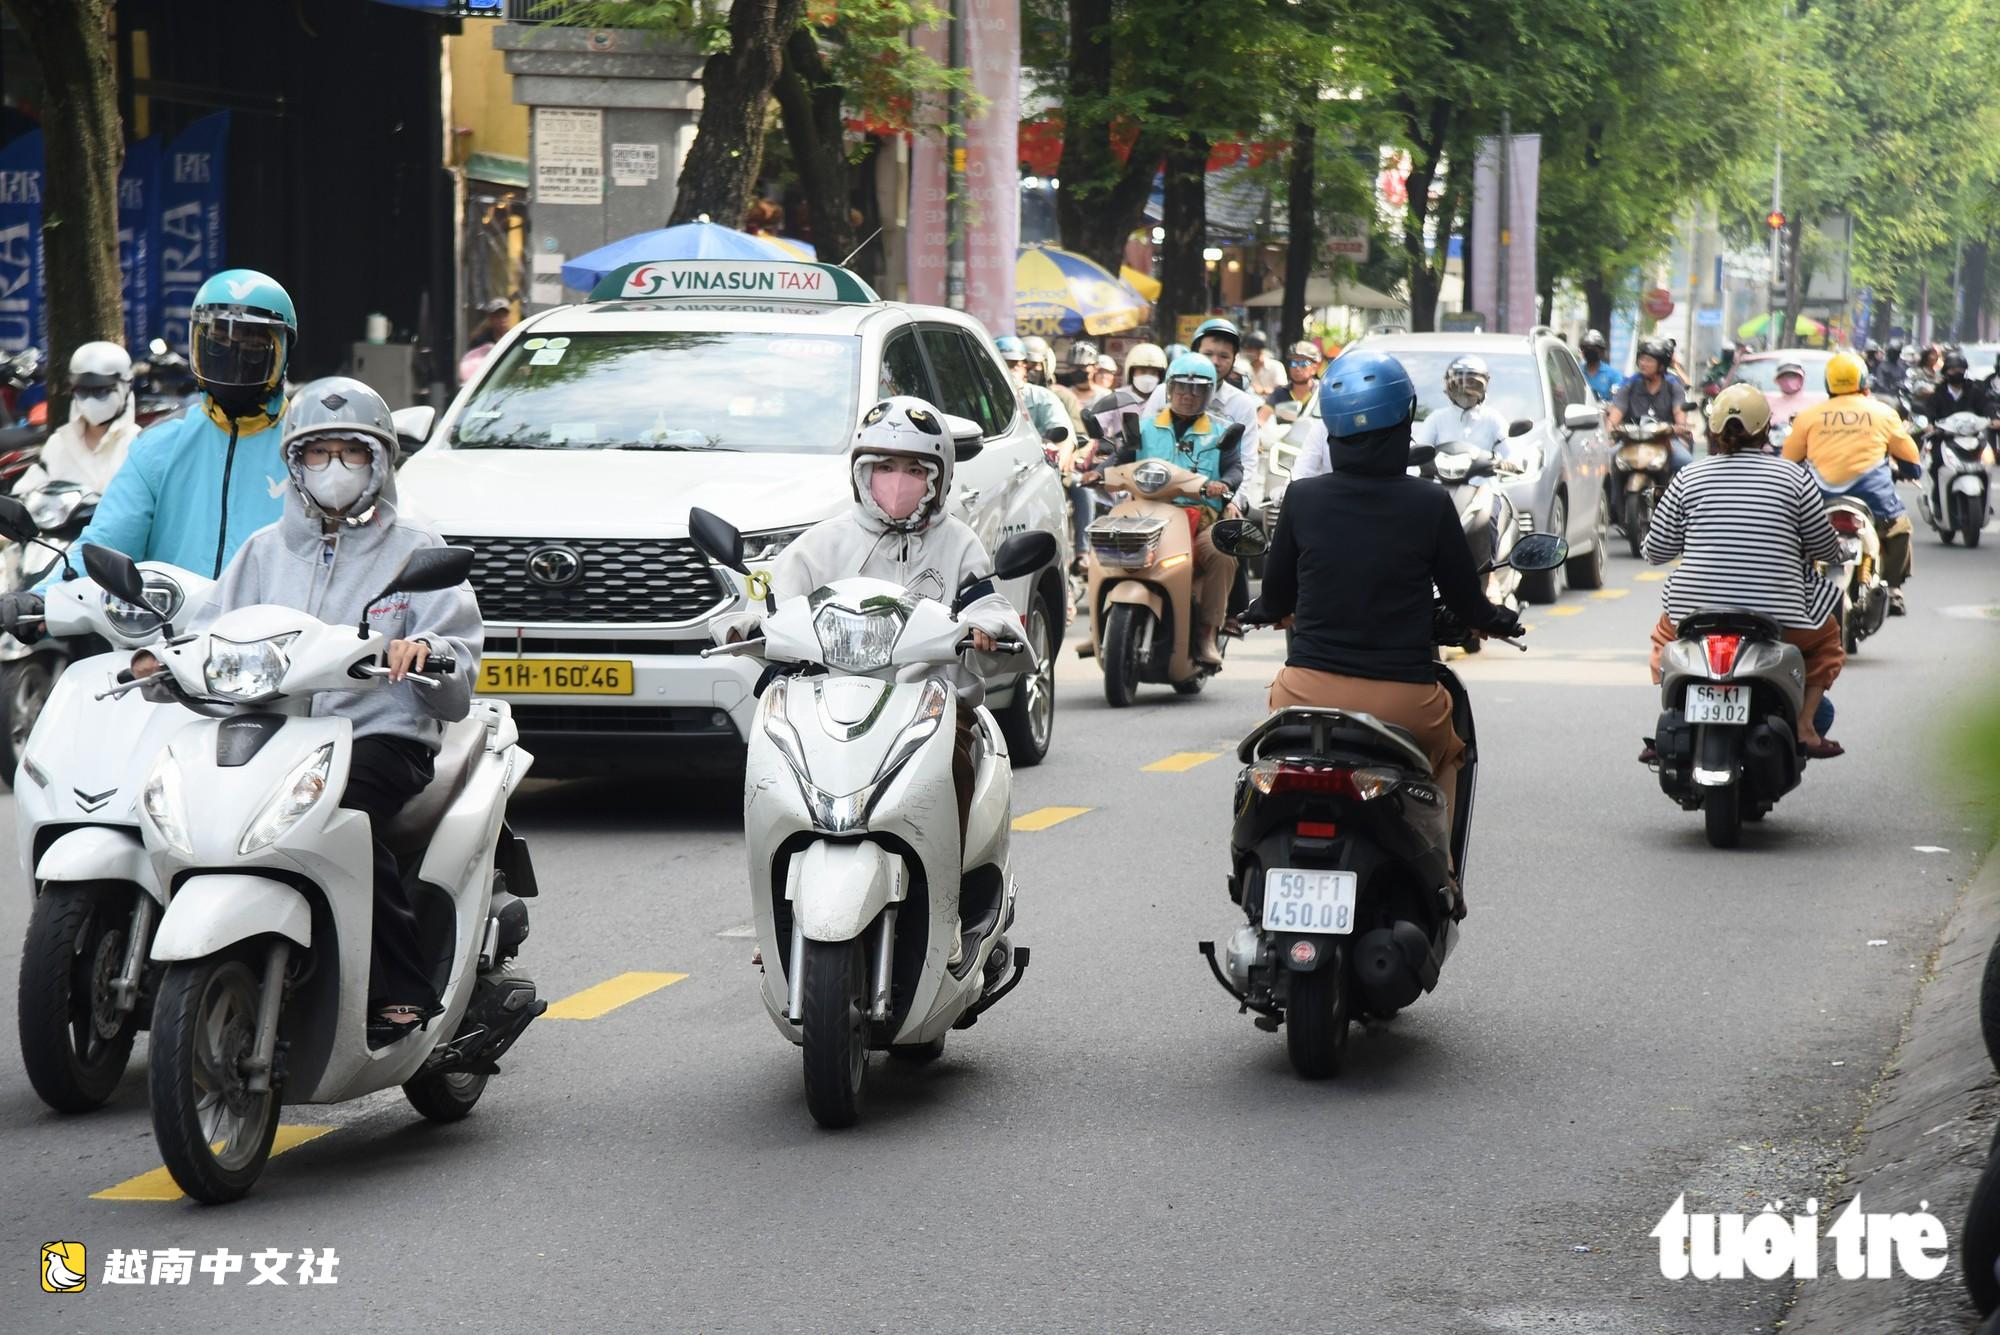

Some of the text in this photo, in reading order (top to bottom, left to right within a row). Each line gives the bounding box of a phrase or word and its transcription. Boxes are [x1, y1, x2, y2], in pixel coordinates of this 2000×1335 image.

[0, 222, 31, 352] URA
[487, 665, 619, 687] 51H-160.46
[1690, 705, 1745, 722] 139.02
[1280, 874, 1340, 900] 59-F1
[1269, 902, 1348, 929] 450.08
